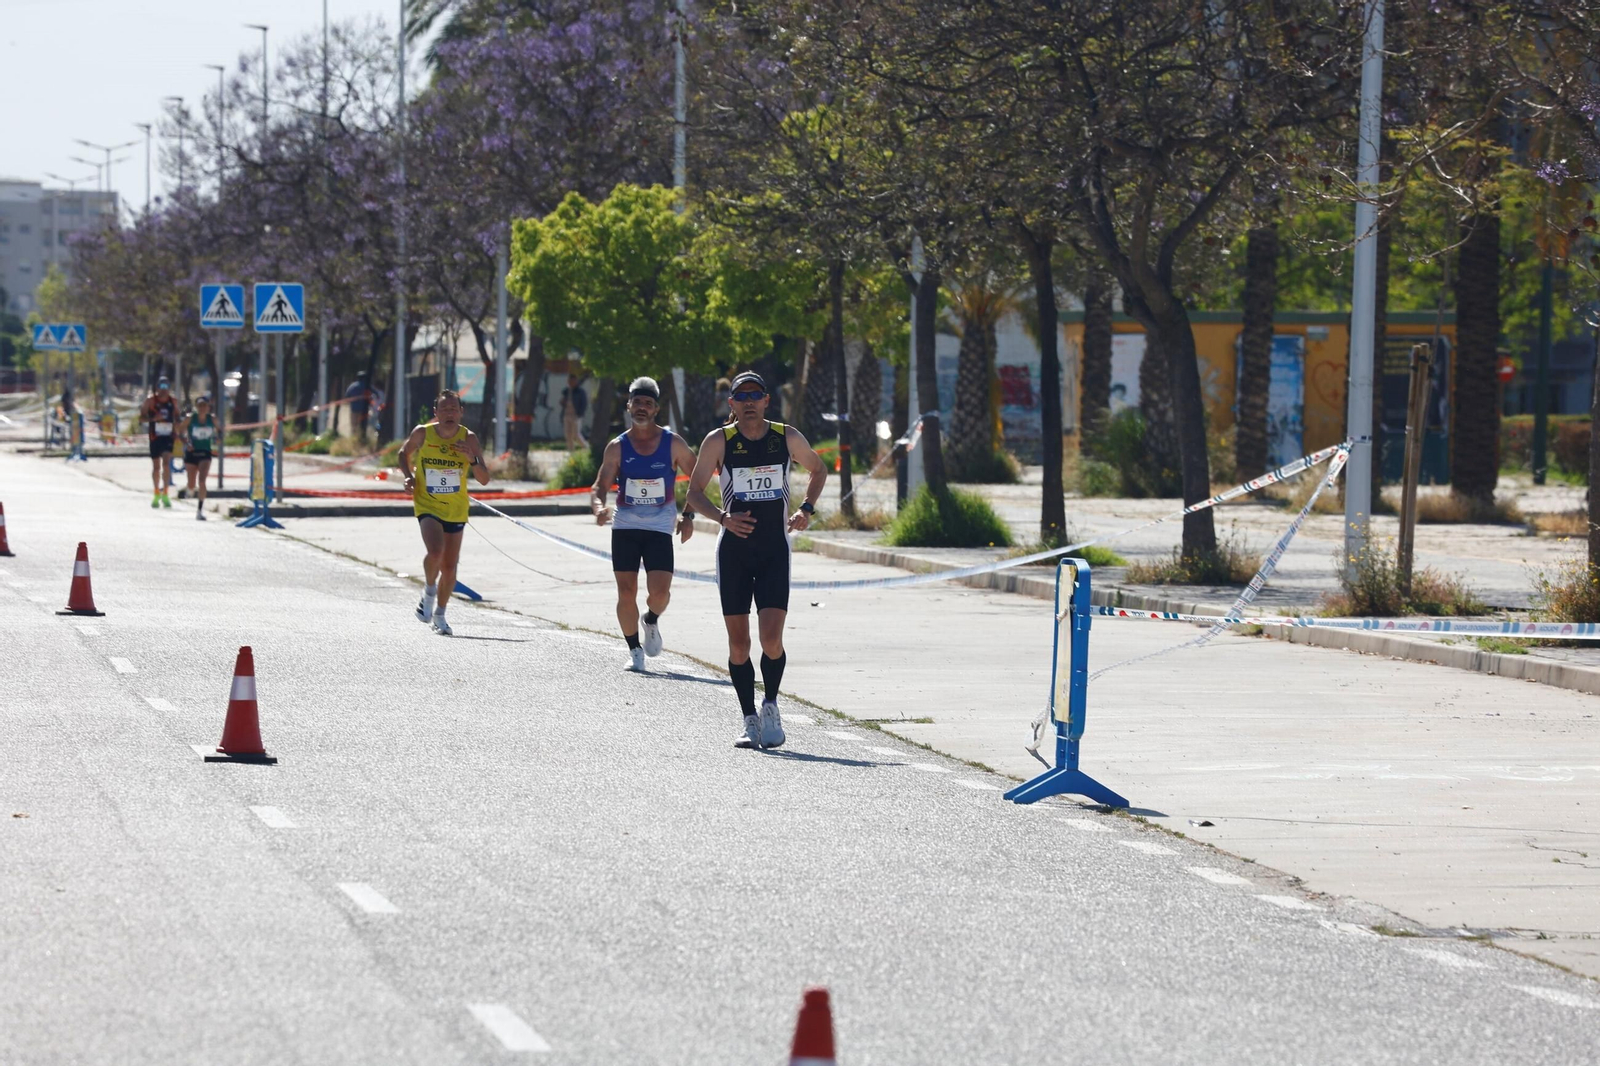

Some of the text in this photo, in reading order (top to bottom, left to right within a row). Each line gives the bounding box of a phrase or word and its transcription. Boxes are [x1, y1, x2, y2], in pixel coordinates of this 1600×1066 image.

[440, 478, 447, 486] 8
[746, 477, 772, 490] 170
[641, 488, 647, 497] 9
